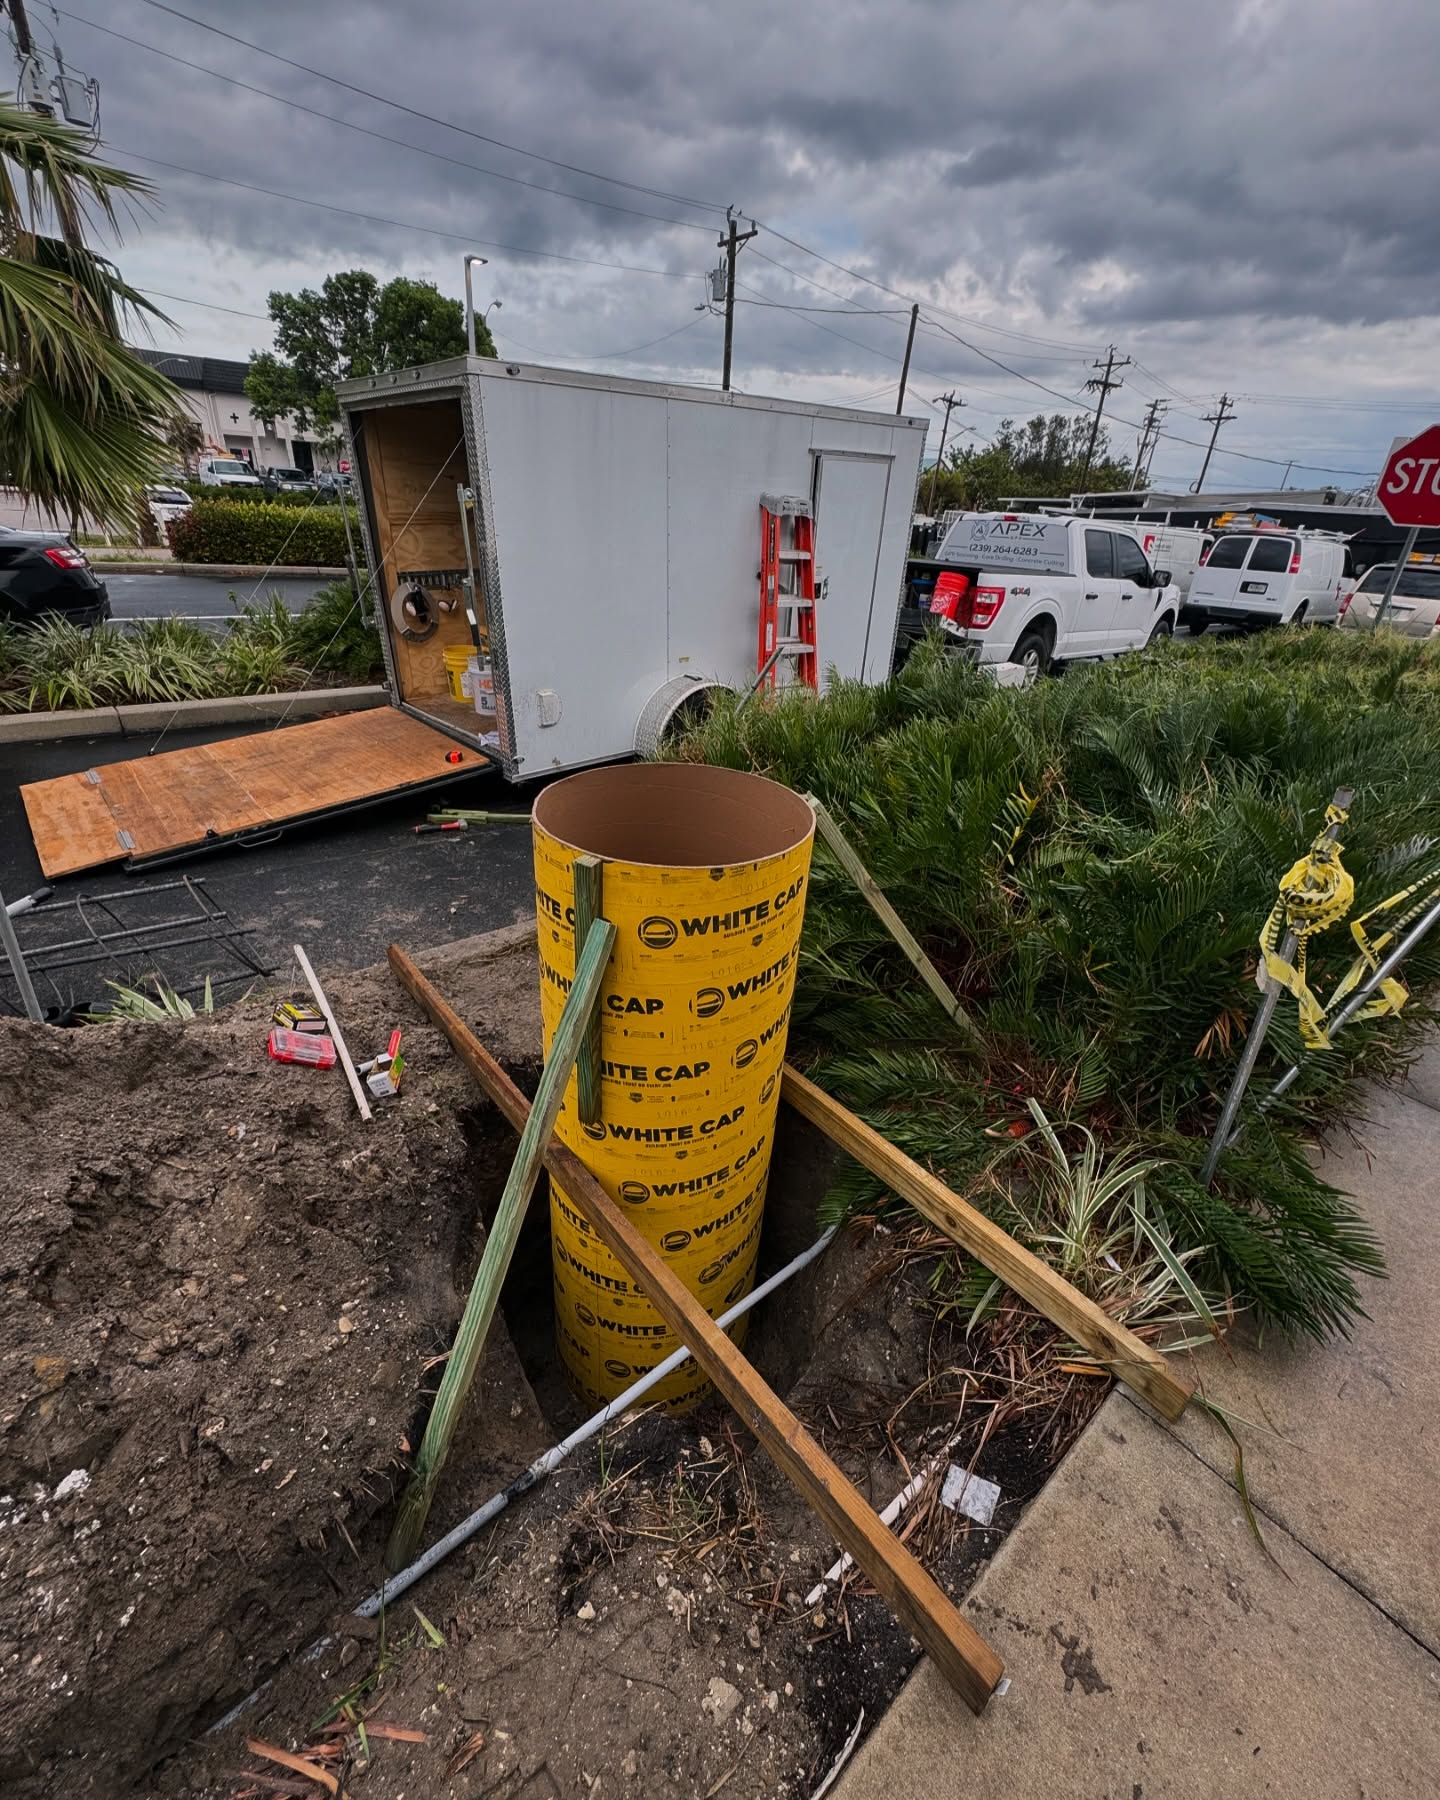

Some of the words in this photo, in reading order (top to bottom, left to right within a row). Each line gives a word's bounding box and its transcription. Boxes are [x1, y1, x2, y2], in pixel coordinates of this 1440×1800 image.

[990, 522, 1048, 537] APEX
[969, 543, 992, 553] (239)
[992, 544, 1038, 557] 264-6283
[481, 696, 488, 706] 5
[680, 900, 770, 937] WHITE
[774, 875, 804, 911] CAP
[544, 960, 573, 993] WHI
[727, 951, 790, 1000] WHITE
[607, 994, 664, 1015] CAP
[602, 1061, 648, 1081] ITE
[654, 1061, 710, 1081] CAP
[608, 1123, 694, 1143] WHITE
[699, 1106, 745, 1134] CAP
[651, 1165, 730, 1198] WHITE
[734, 1135, 766, 1171] CAP
[692, 1190, 754, 1239] WHITE
[567, 1251, 628, 1292] WHITE
[596, 1315, 667, 1337] WHITE
